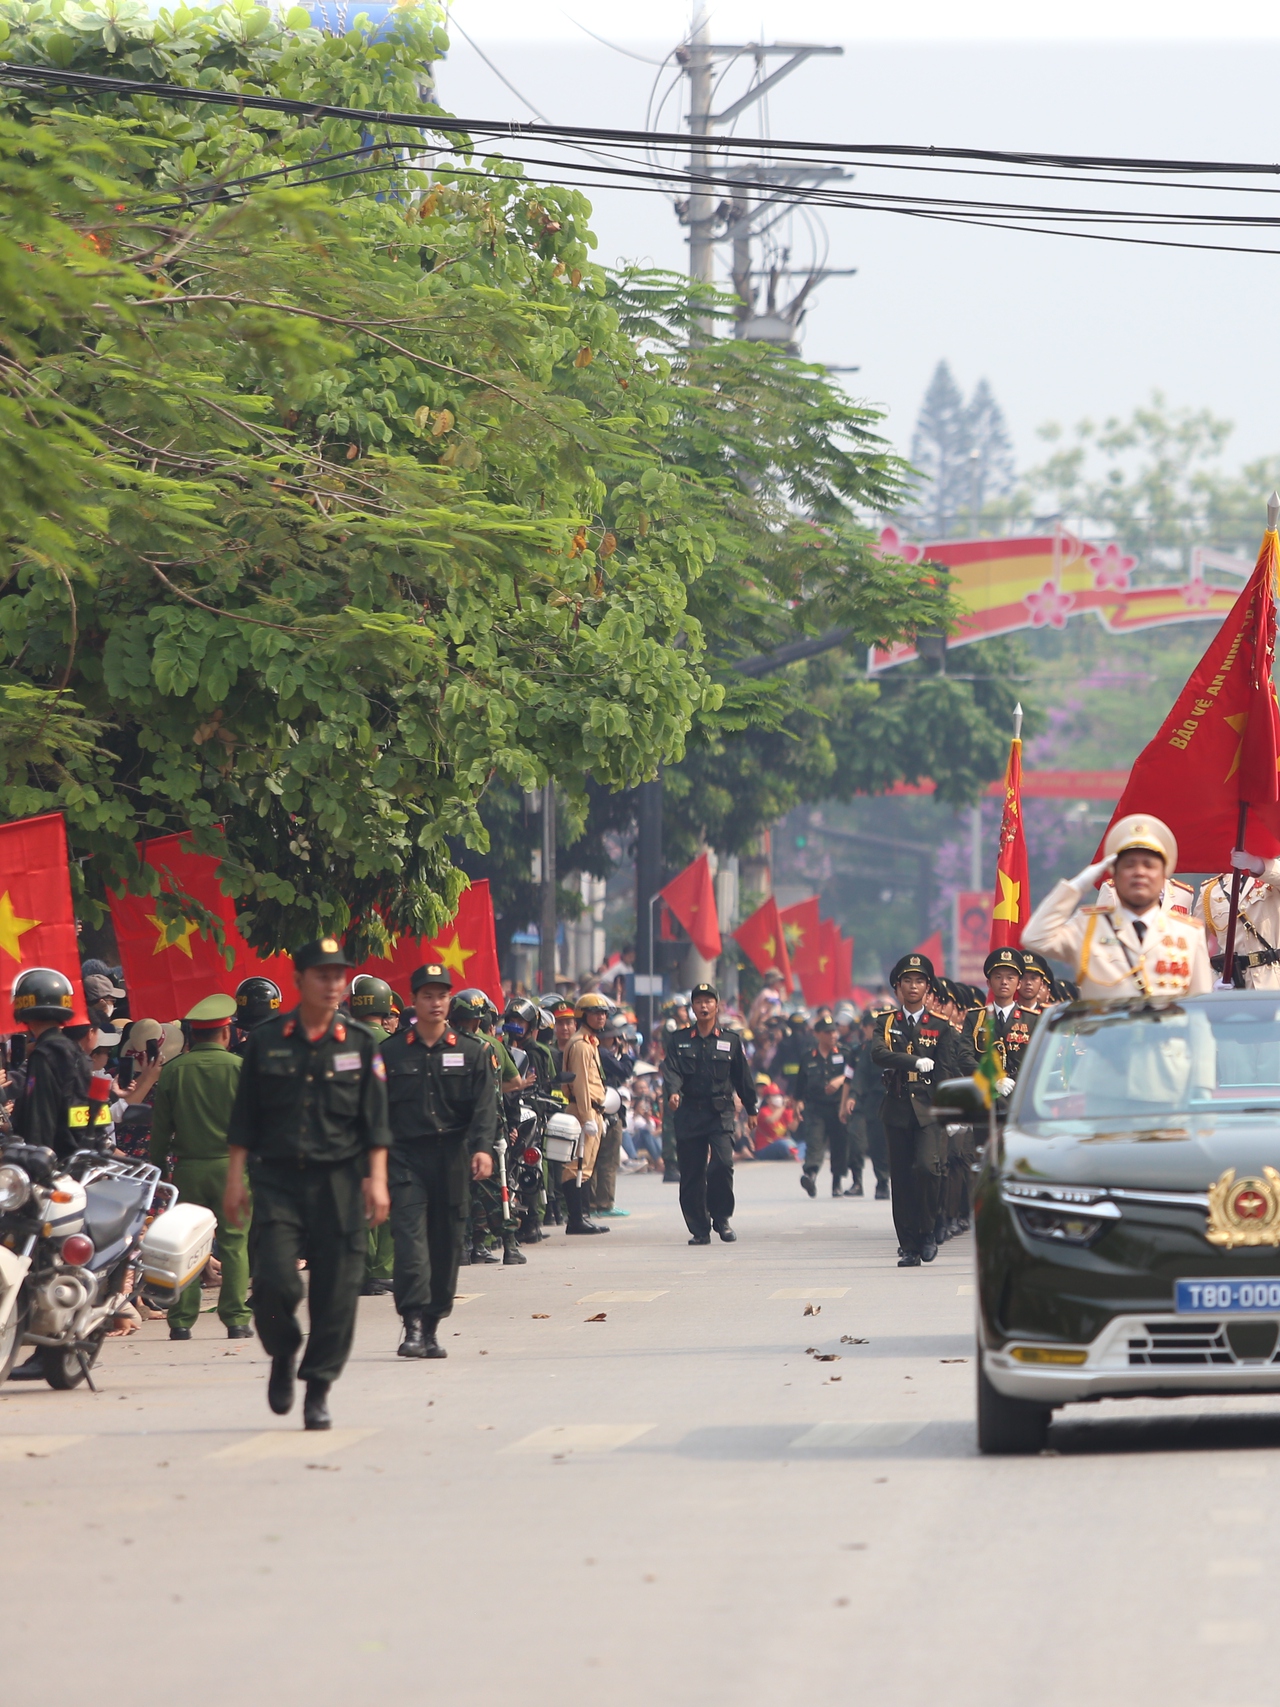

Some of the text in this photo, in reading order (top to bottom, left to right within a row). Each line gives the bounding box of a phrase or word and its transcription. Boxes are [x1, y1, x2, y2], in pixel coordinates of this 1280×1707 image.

[1168, 632, 1245, 750] BẢO VỆ AN NINH
[352, 994, 375, 1006] CSTT
[187, 1238, 212, 1270] CSTT
